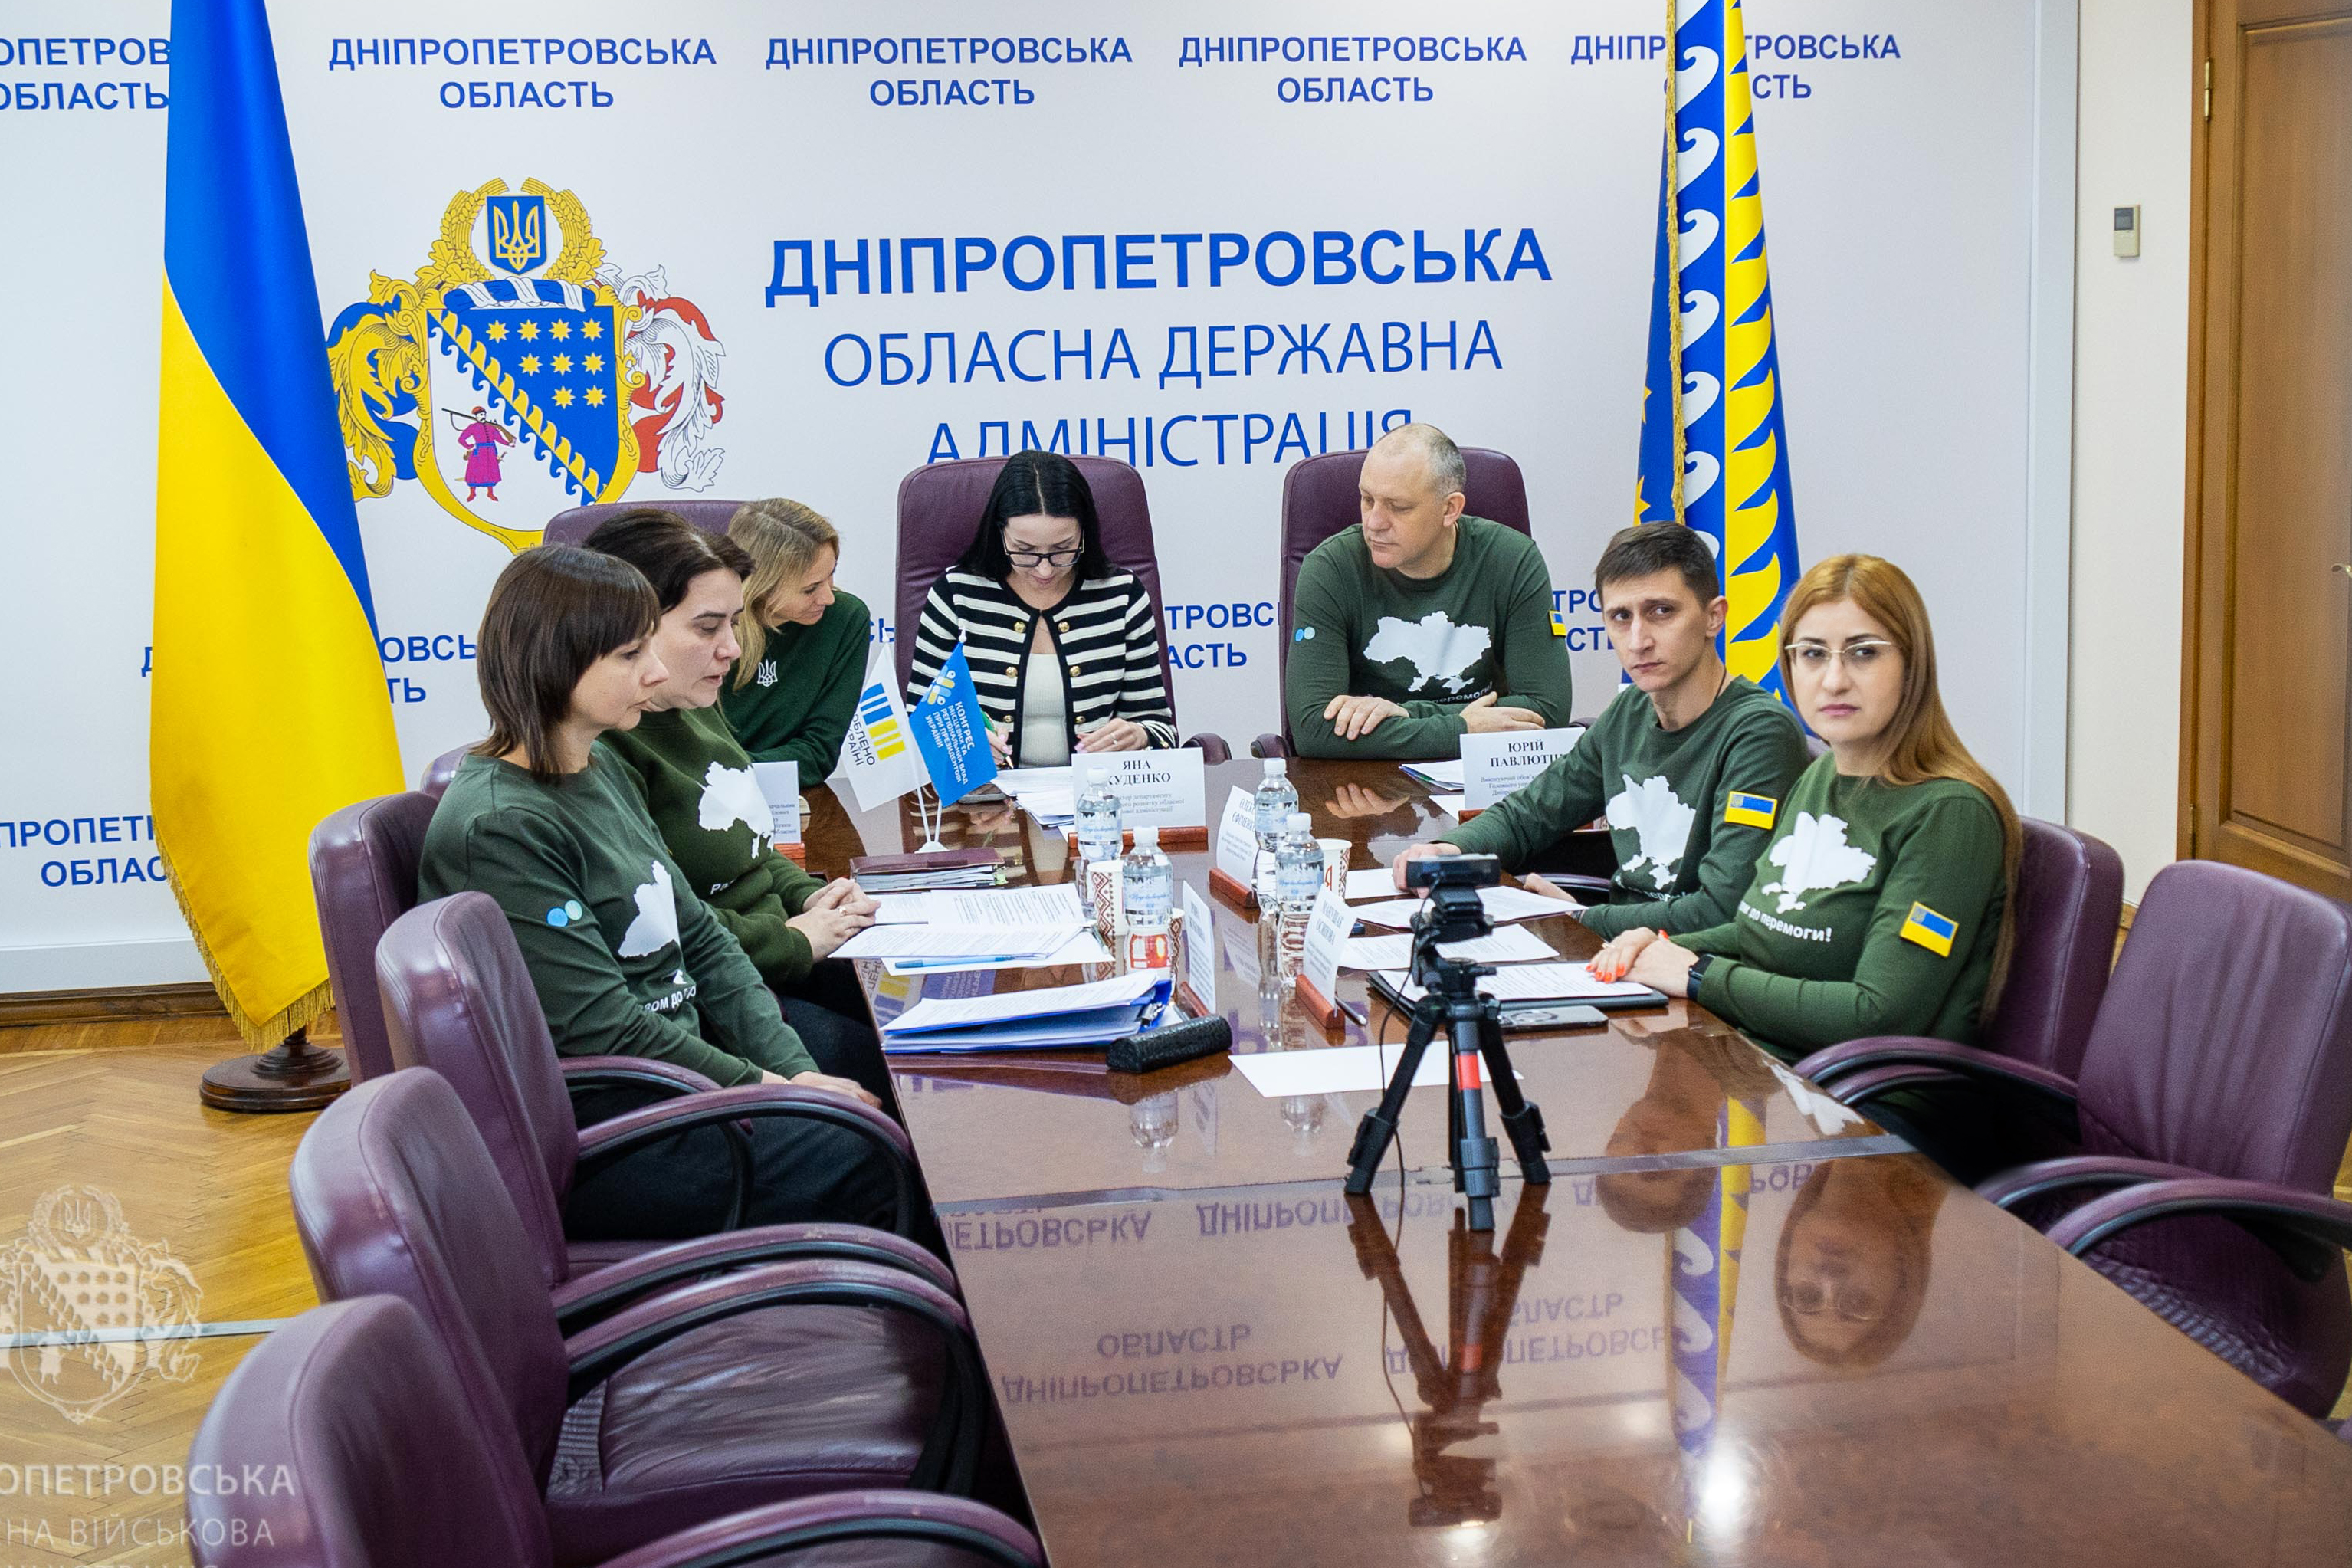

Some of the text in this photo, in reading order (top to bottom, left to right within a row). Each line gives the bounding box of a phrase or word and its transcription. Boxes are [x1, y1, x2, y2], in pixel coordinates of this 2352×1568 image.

[329, 38, 717, 71] ДНІПРОПЕТРОВСЬКА
[766, 38, 1133, 70] ДНІПРОПЕТРОВСЬКА
[1179, 37, 1527, 68] ДНІПРОПЕТРОВСЬКА
[439, 80, 614, 109] ОБЛАСТЬ
[870, 79, 1035, 107] ОБЛАСТЬ
[1278, 77, 1434, 103] ОБЛАСТЬ
[765, 228, 1552, 308] ДНІПРОПЕТРОВСЬКА
[825, 320, 1502, 389] ОБЛАСНА ДЕРЖАВНА
[955, 700, 975, 750] КОНГРЕС
[848, 728, 864, 766] РАЇНІ
[1507, 738, 1544, 753] ЮРІЙ
[1123, 759, 1151, 770] ЯНА
[1760, 913, 1833, 943] перемоги!
